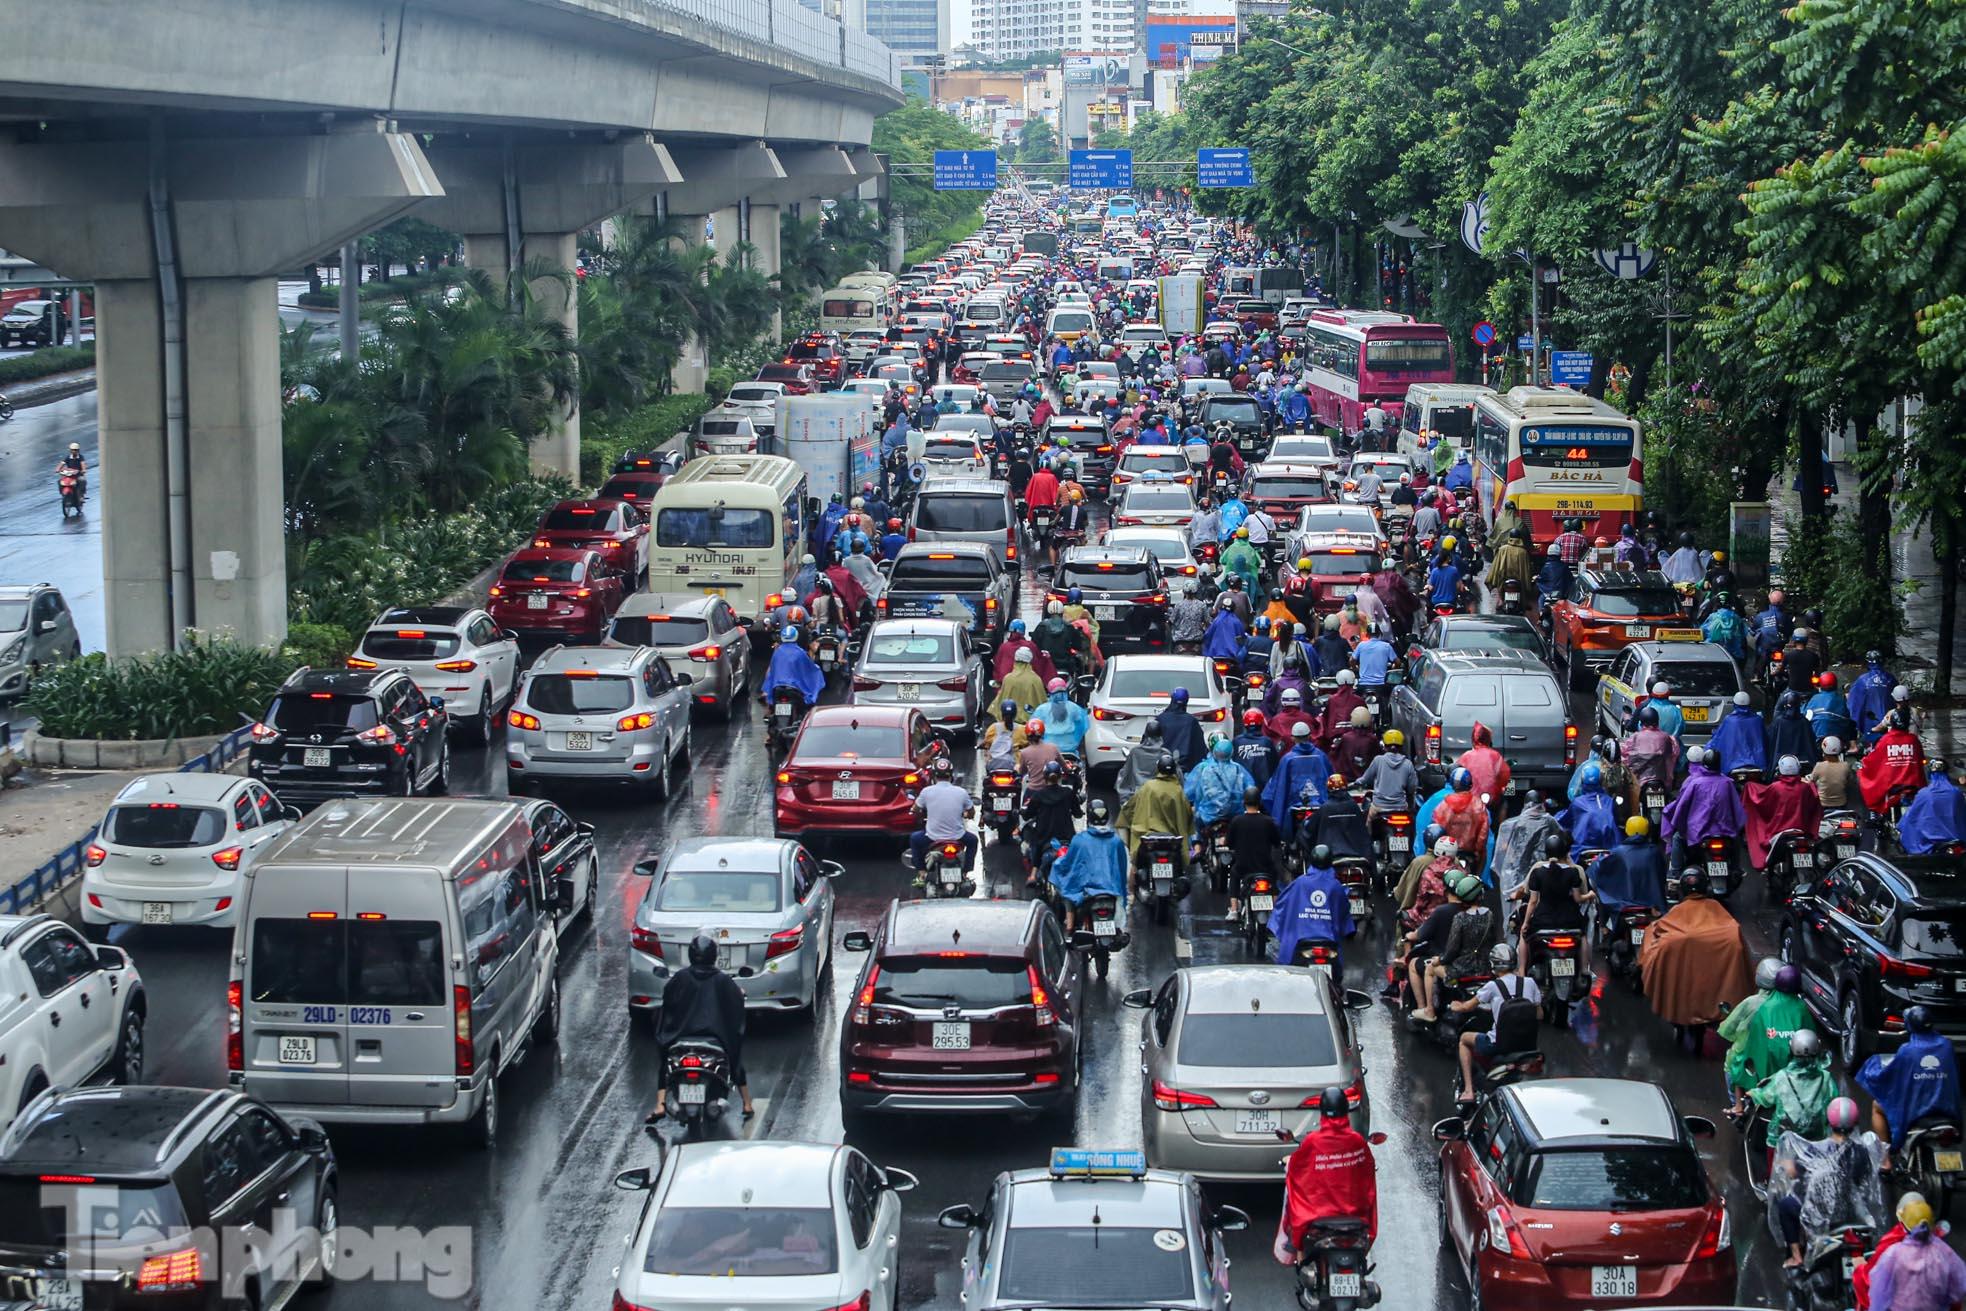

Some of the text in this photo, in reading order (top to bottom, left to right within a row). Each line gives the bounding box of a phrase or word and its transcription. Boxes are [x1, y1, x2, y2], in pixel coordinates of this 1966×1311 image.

[1528, 431, 1537, 441] 44
[1567, 448, 1587, 459] 44
[1550, 469, 1603, 480] BẮC HÀ
[686, 554, 744, 563] HYUNDAI
[1887, 744, 1913, 756] HMH
[304, 1006, 336, 1023] 29LD
[350, 1008, 391, 1024] 02376
[942, 1024, 960, 1035] 30E
[287, 1039, 308, 1049] 29LD
[934, 1036, 969, 1048] 295.53
[283, 1050, 312, 1060] 023.76
[1249, 1110, 1268, 1120] 30H
[1240, 1122, 1277, 1131] 711.32
[1087, 1152, 1114, 1167] SÔNG
[1604, 1267, 1626, 1280] 30A
[1334, 1276, 1356, 1285] 89-E1
[48, 1280, 71, 1294] 29A
[1595, 1282, 1635, 1296] 330.18
